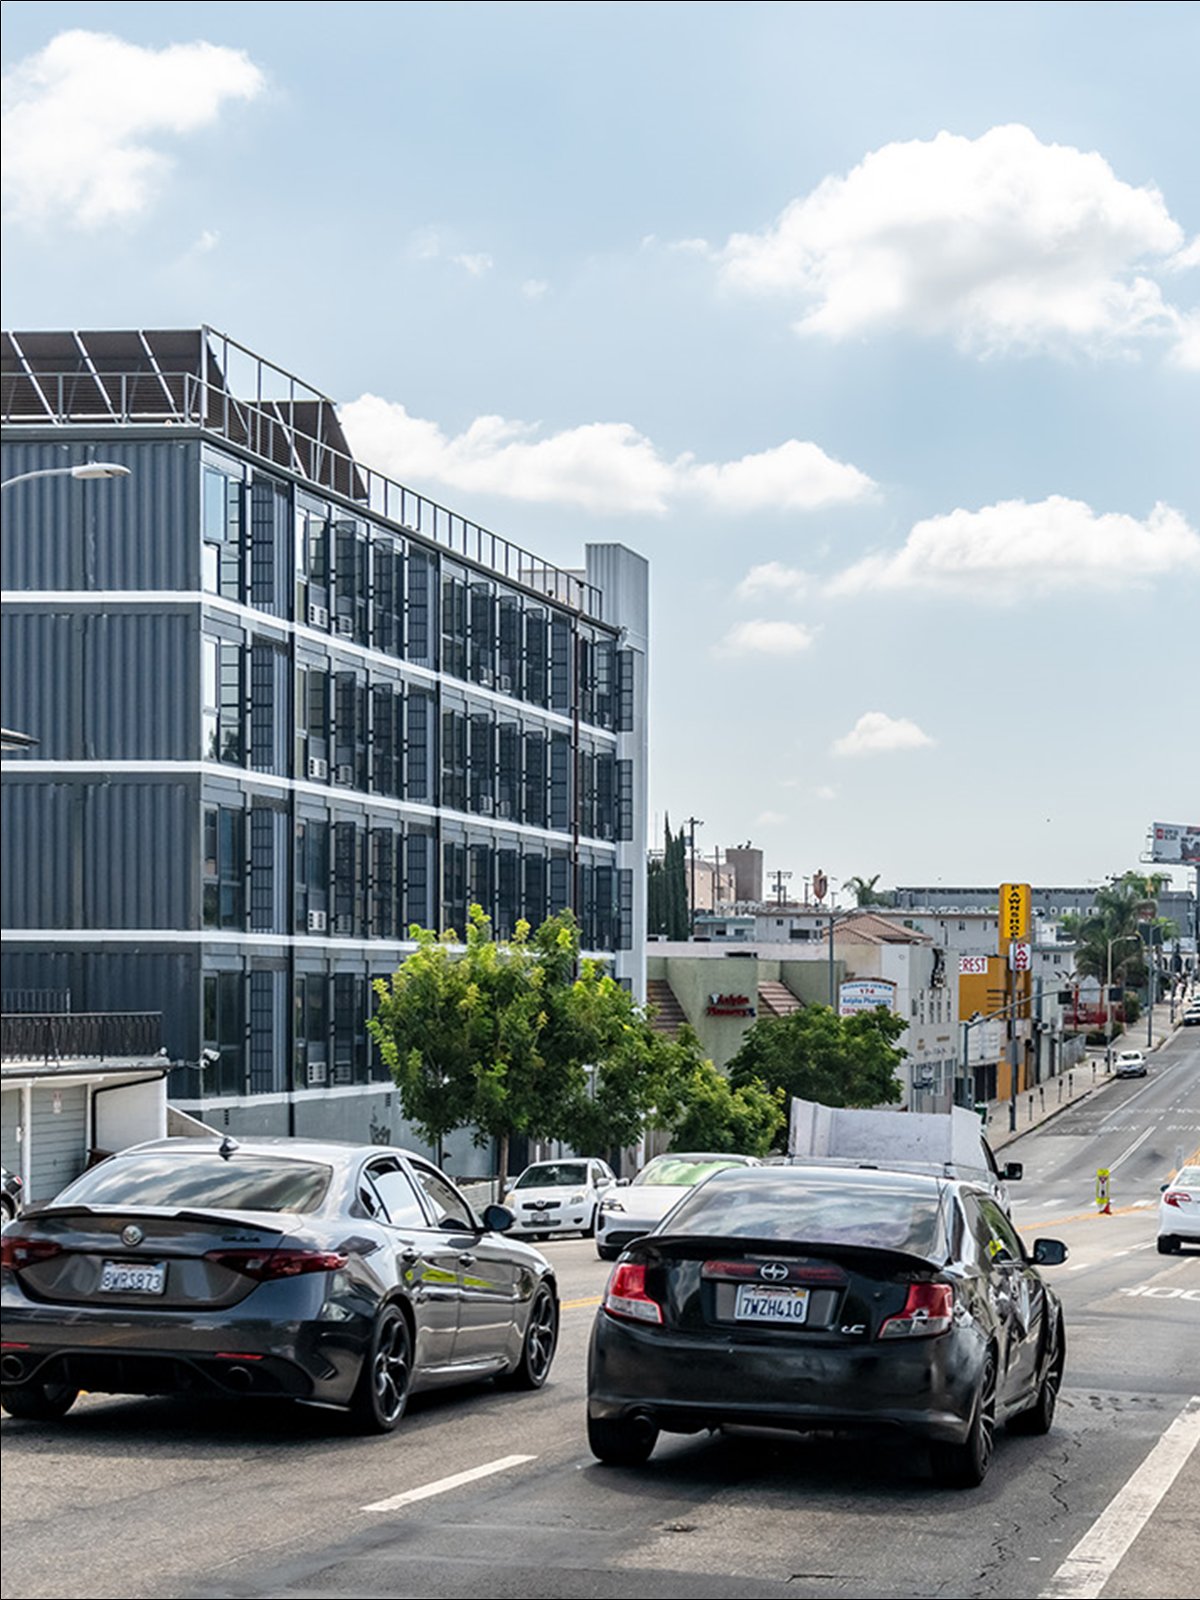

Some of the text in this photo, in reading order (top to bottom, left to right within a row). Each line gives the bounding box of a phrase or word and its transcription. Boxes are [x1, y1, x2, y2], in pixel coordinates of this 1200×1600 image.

[1008, 885, 1021, 937] PAWNSHOP
[1015, 943, 1028, 970] PAWN
[742, 1297, 804, 1318] 7WZH410
